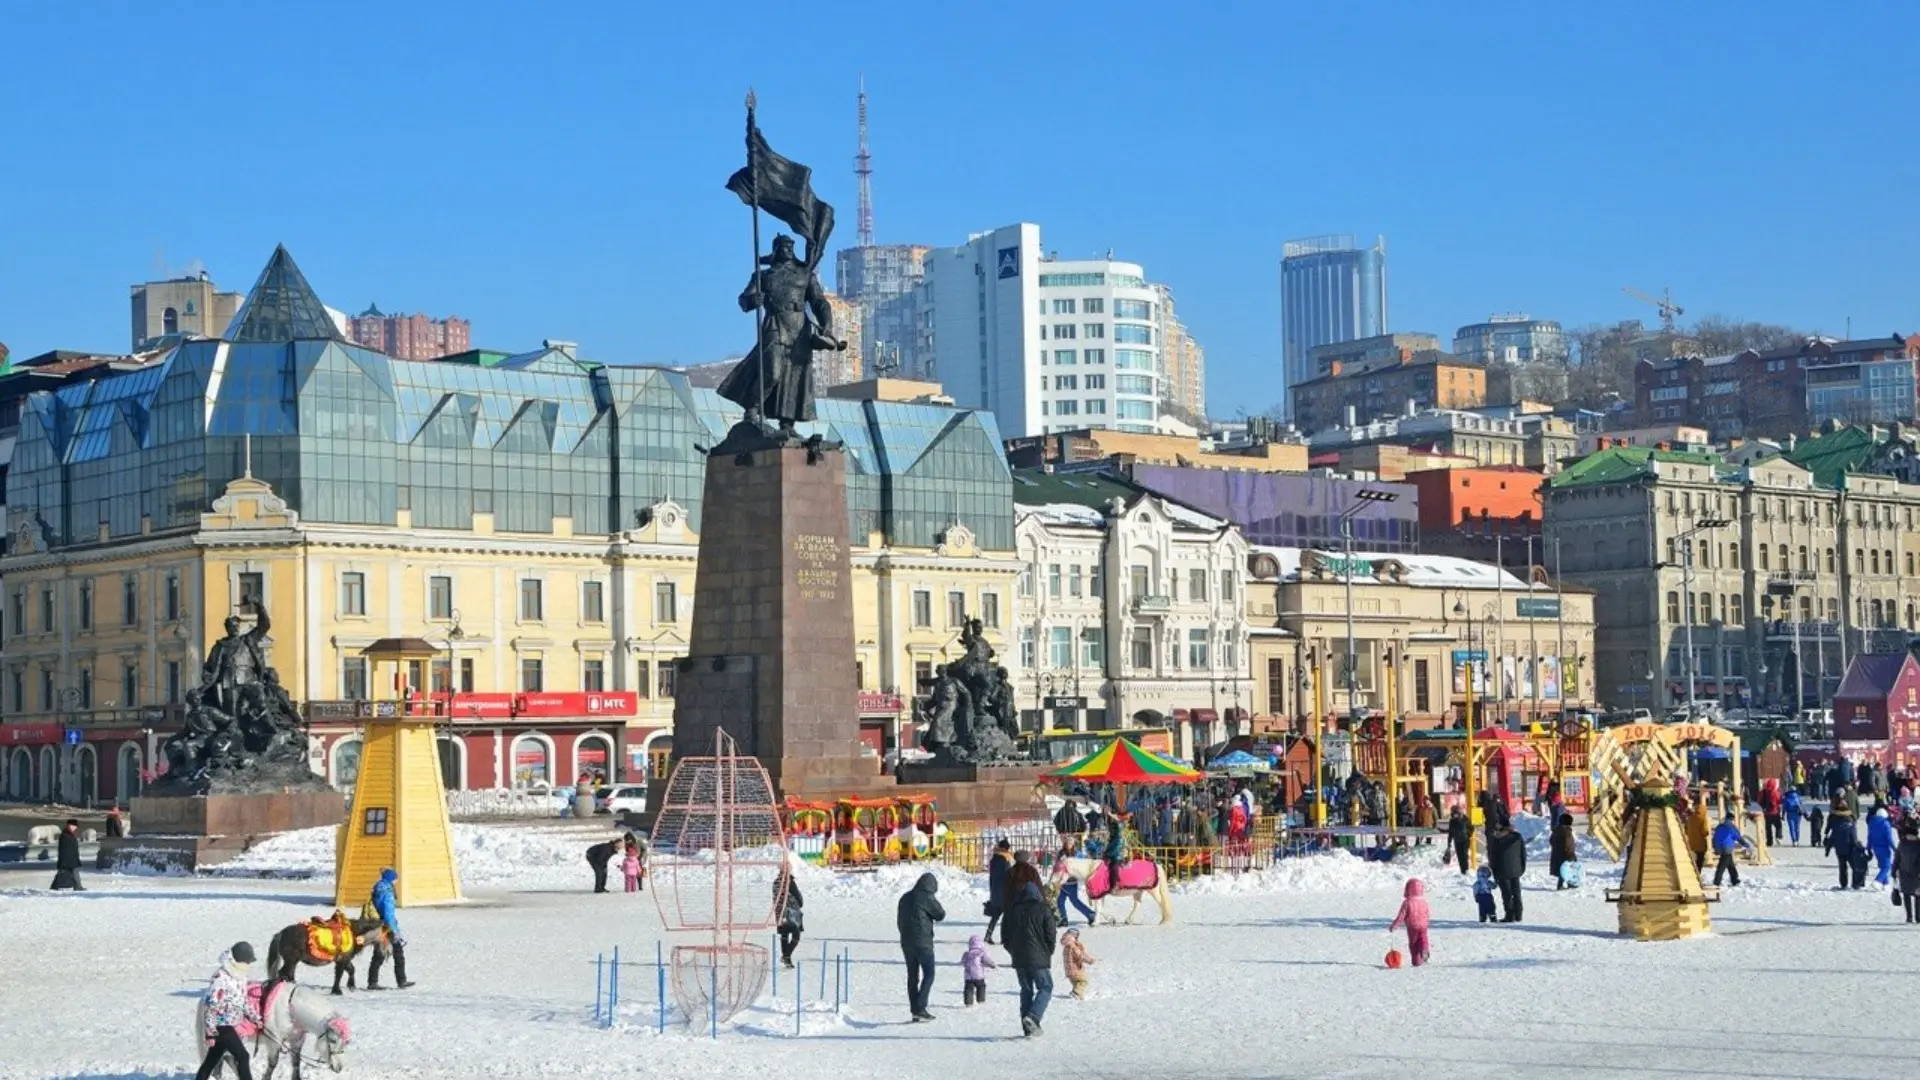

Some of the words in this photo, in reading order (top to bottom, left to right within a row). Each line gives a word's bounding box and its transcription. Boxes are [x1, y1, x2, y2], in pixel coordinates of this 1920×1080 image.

[798, 551, 837, 561] СОВЕТОВ
[604, 698, 625, 709] МТС
[1674, 725, 1717, 740] 2016
